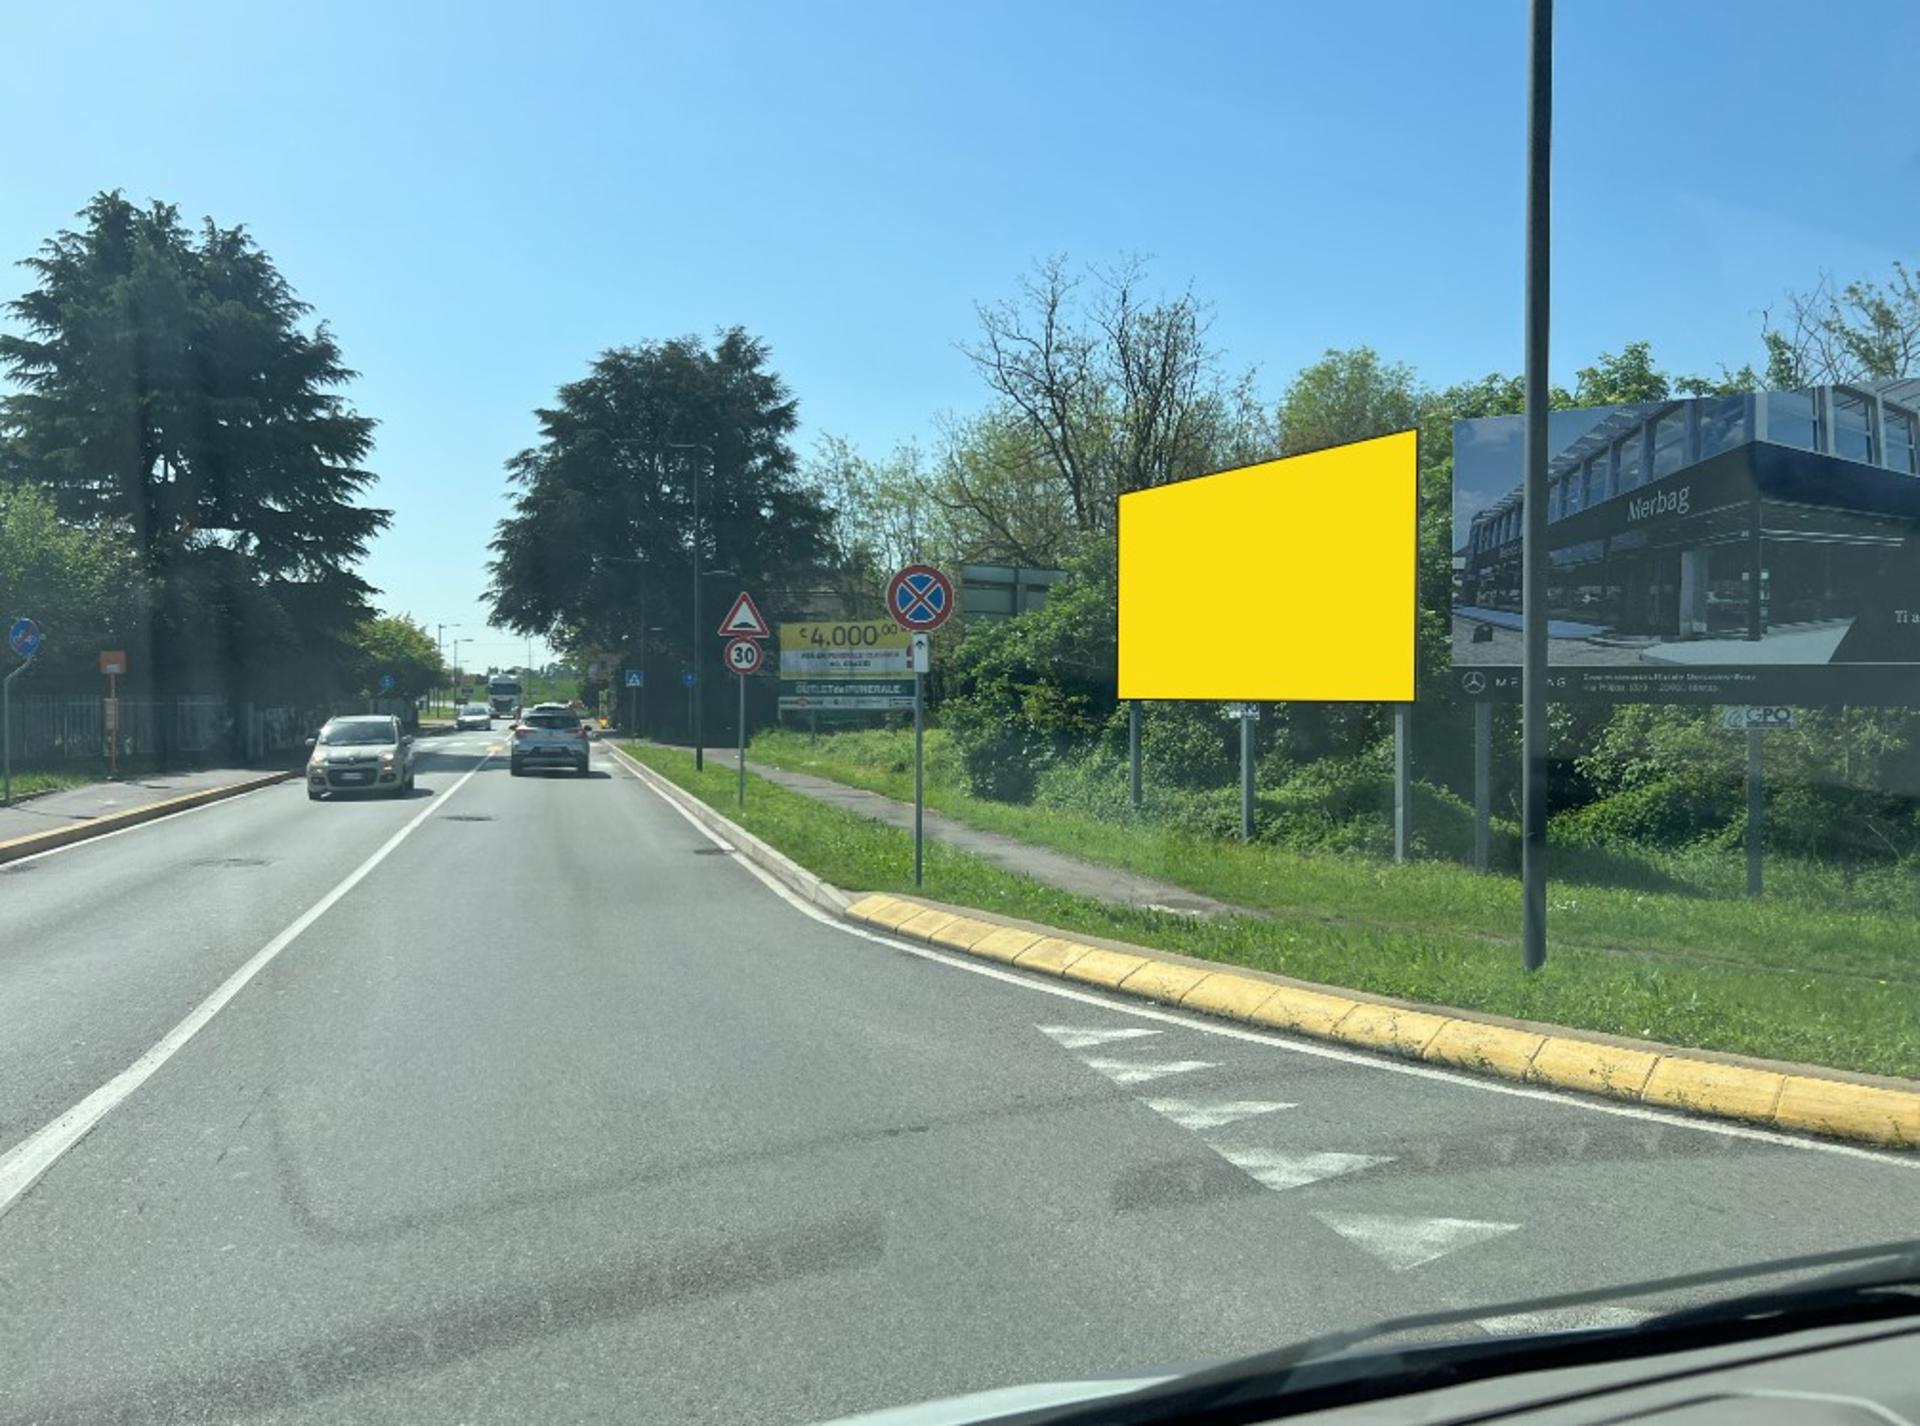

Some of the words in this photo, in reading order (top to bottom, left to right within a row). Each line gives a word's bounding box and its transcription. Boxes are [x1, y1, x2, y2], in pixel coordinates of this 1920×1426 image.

[1627, 485, 1690, 522] Merbag
[734, 646, 755, 663] 30
[1495, 677, 1566, 687] MEAG
[1746, 707, 1791, 722] GPO
